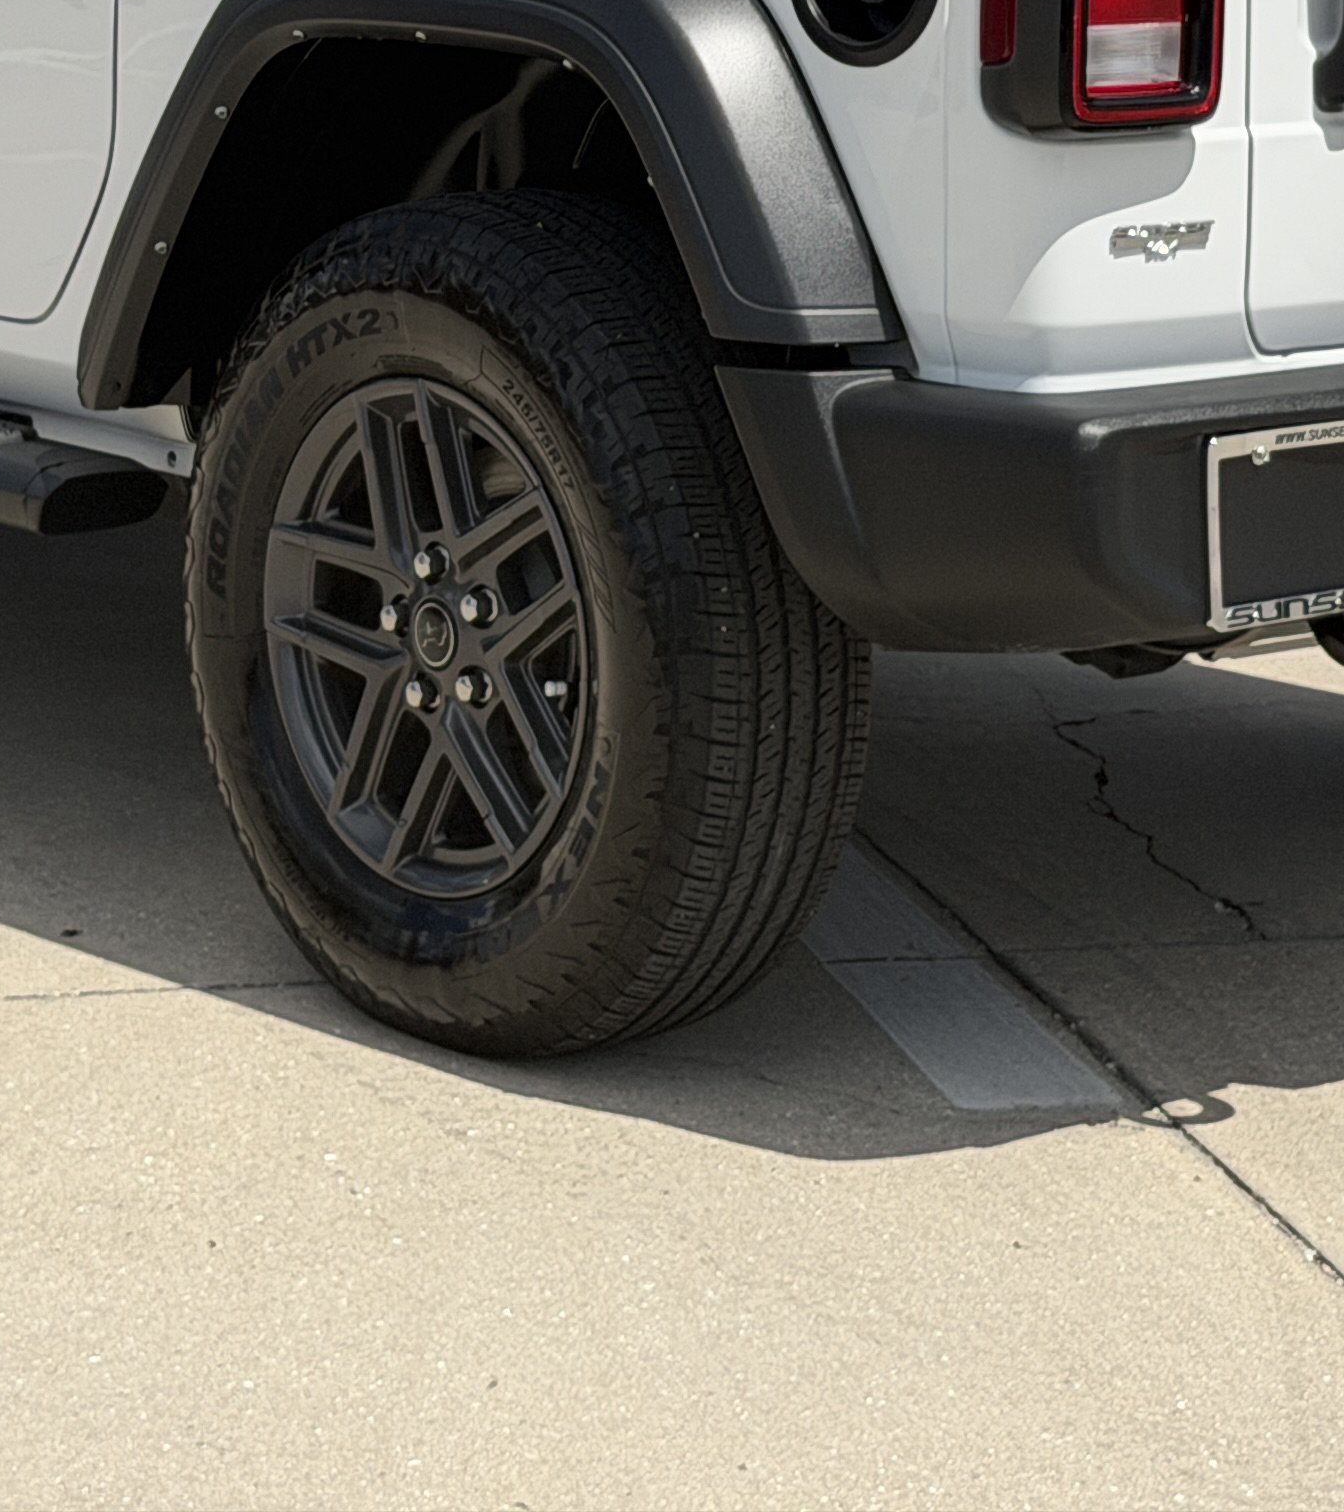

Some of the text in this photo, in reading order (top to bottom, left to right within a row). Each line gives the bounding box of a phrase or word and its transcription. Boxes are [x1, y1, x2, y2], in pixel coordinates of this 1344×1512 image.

[207, 308, 383, 600] ROADIAN HTX2
[501, 379, 574, 488] 245/75R17
